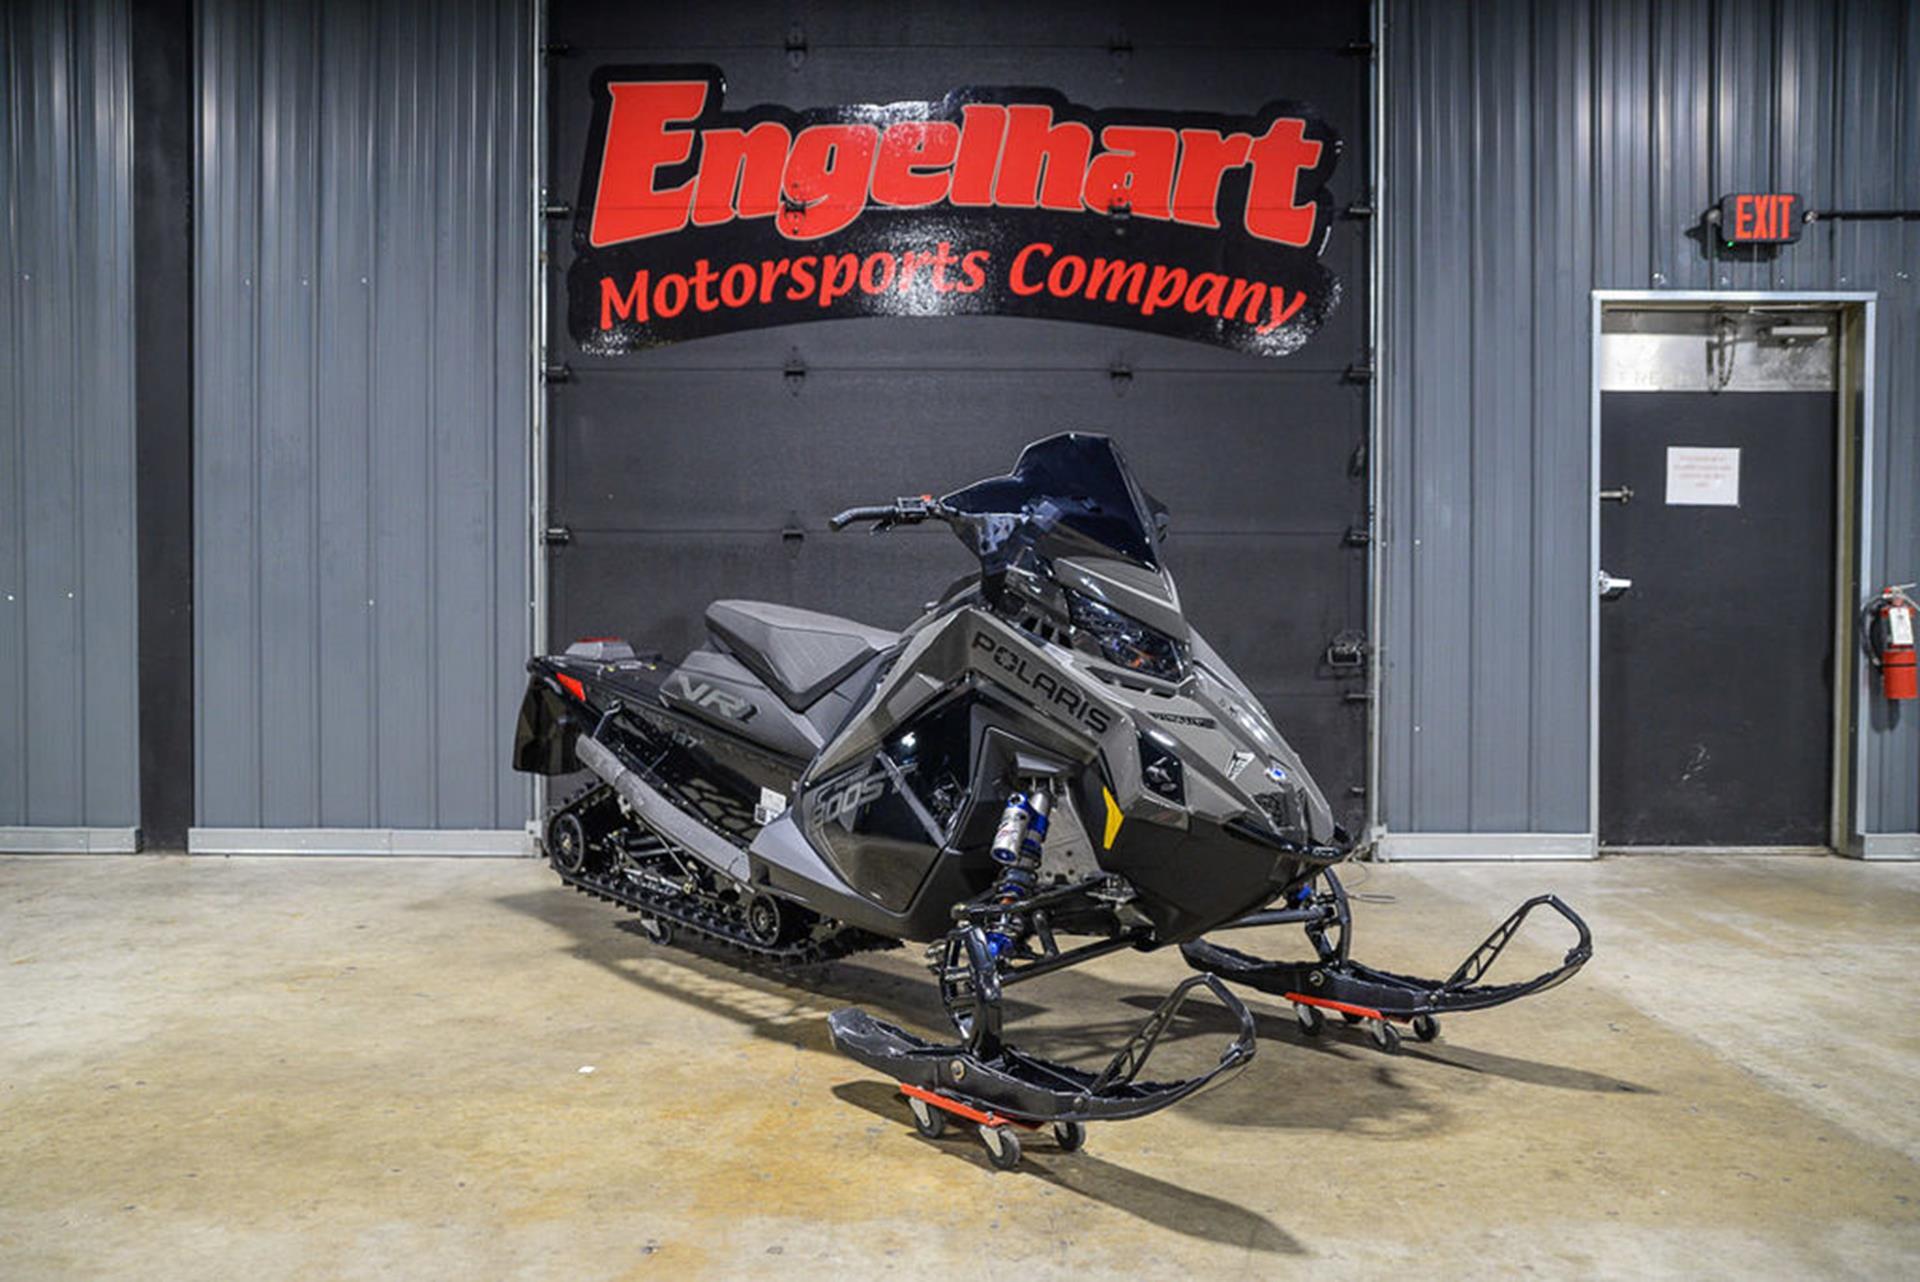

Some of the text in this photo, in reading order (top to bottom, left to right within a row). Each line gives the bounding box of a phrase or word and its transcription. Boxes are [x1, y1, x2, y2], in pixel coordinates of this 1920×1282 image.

[590, 81, 1323, 248] Engelhart
[1735, 194, 1795, 240] EXIT
[600, 242, 1308, 334] Motorsports Company
[972, 631, 1111, 734] POLARIS
